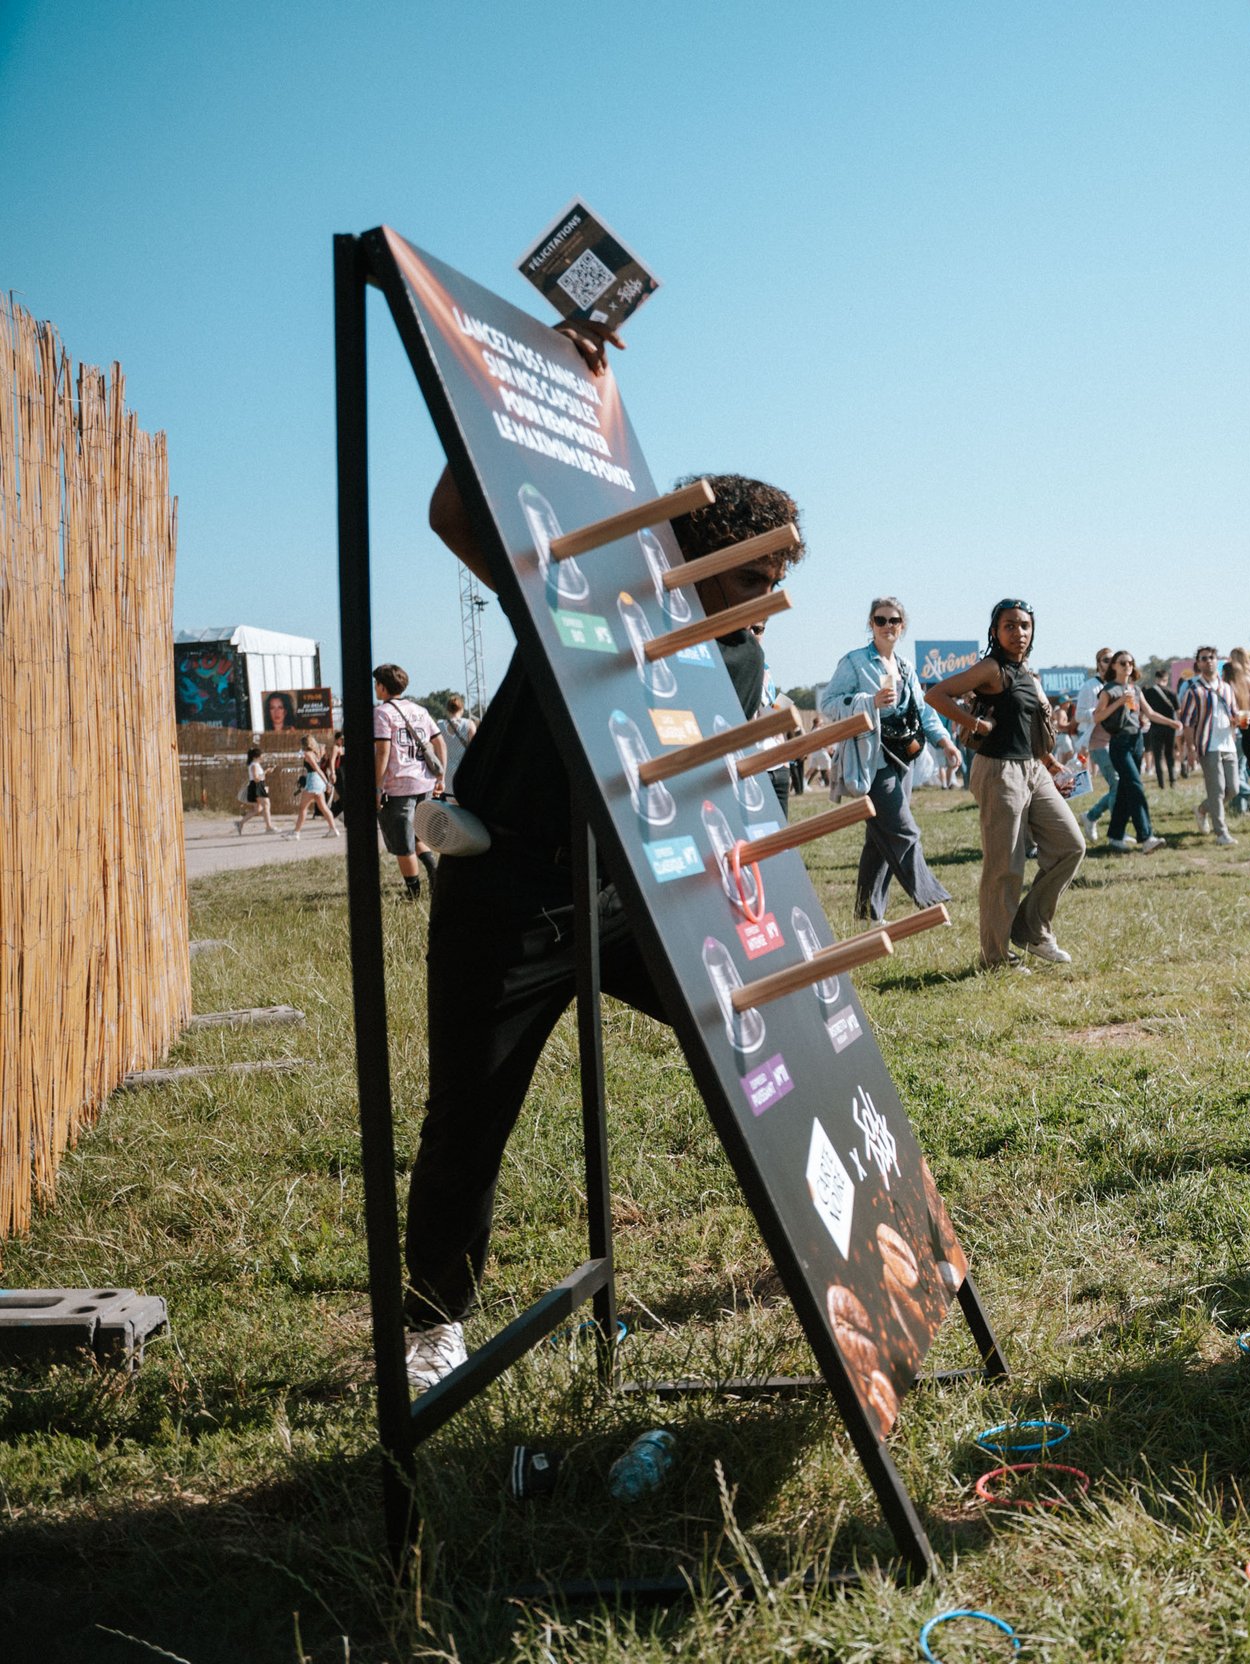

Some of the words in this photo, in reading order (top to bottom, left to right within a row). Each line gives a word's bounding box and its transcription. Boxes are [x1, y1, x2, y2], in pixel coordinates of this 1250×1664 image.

[528, 214, 582, 271] FÉLICITATIONS
[451, 306, 514, 360] LANCEZ
[507, 337, 542, 374] VOS
[544, 358, 603, 407] ANNEAUX
[482, 349, 516, 387] SUR
[511, 364, 545, 401] NOS
[540, 380, 601, 429] CAPSULES
[492, 410, 517, 445] LE
[511, 419, 582, 470] MAXIMUM
[576, 447, 599, 476] DE
[592, 455, 636, 492] POINTS
[498, 385, 543, 426] POUR
[539, 404, 612, 458] REMPORTER
